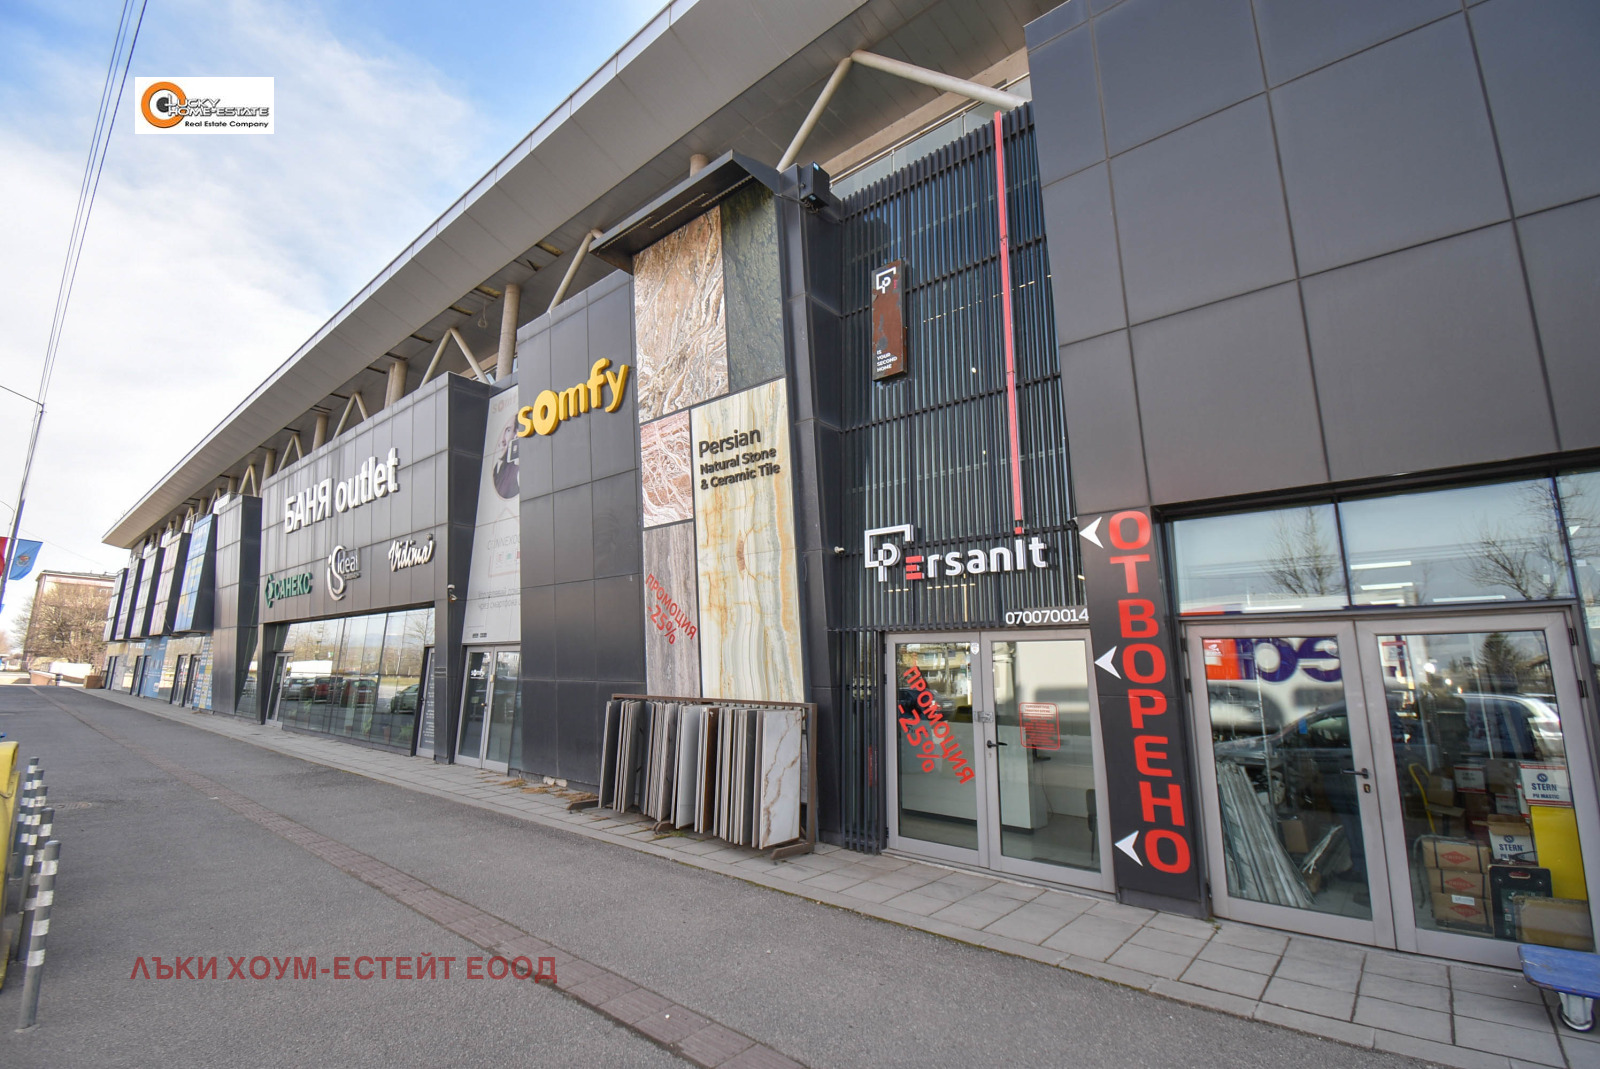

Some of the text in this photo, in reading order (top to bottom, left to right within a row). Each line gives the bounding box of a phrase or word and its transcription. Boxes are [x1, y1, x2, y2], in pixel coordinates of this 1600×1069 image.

[877, 352, 891, 361] YOUR
[877, 356, 898, 366] SECOND
[877, 363, 892, 372] HOME
[517, 357, 629, 437] somfy
[699, 428, 761, 458] Persian
[700, 446, 777, 475] Natural Stone
[284, 447, 399, 534] БАНЯ outlet
[700, 462, 781, 490] & Ceramic Tile
[337, 548, 360, 574] Ideal
[388, 533, 436, 572] Vidima
[274, 572, 313, 600] САНЕКС
[645, 573, 698, 640] ПРОМОЦИЯ
[1005, 608, 1089, 625] 070070014
[647, 604, 676, 645] -25%
[1108, 510, 1191, 874] ОТВОРЕНО
[898, 704, 940, 773] -25%
[903, 665, 975, 784] ПРОМОЦИЯ
[1531, 783, 1558, 791] STERN
